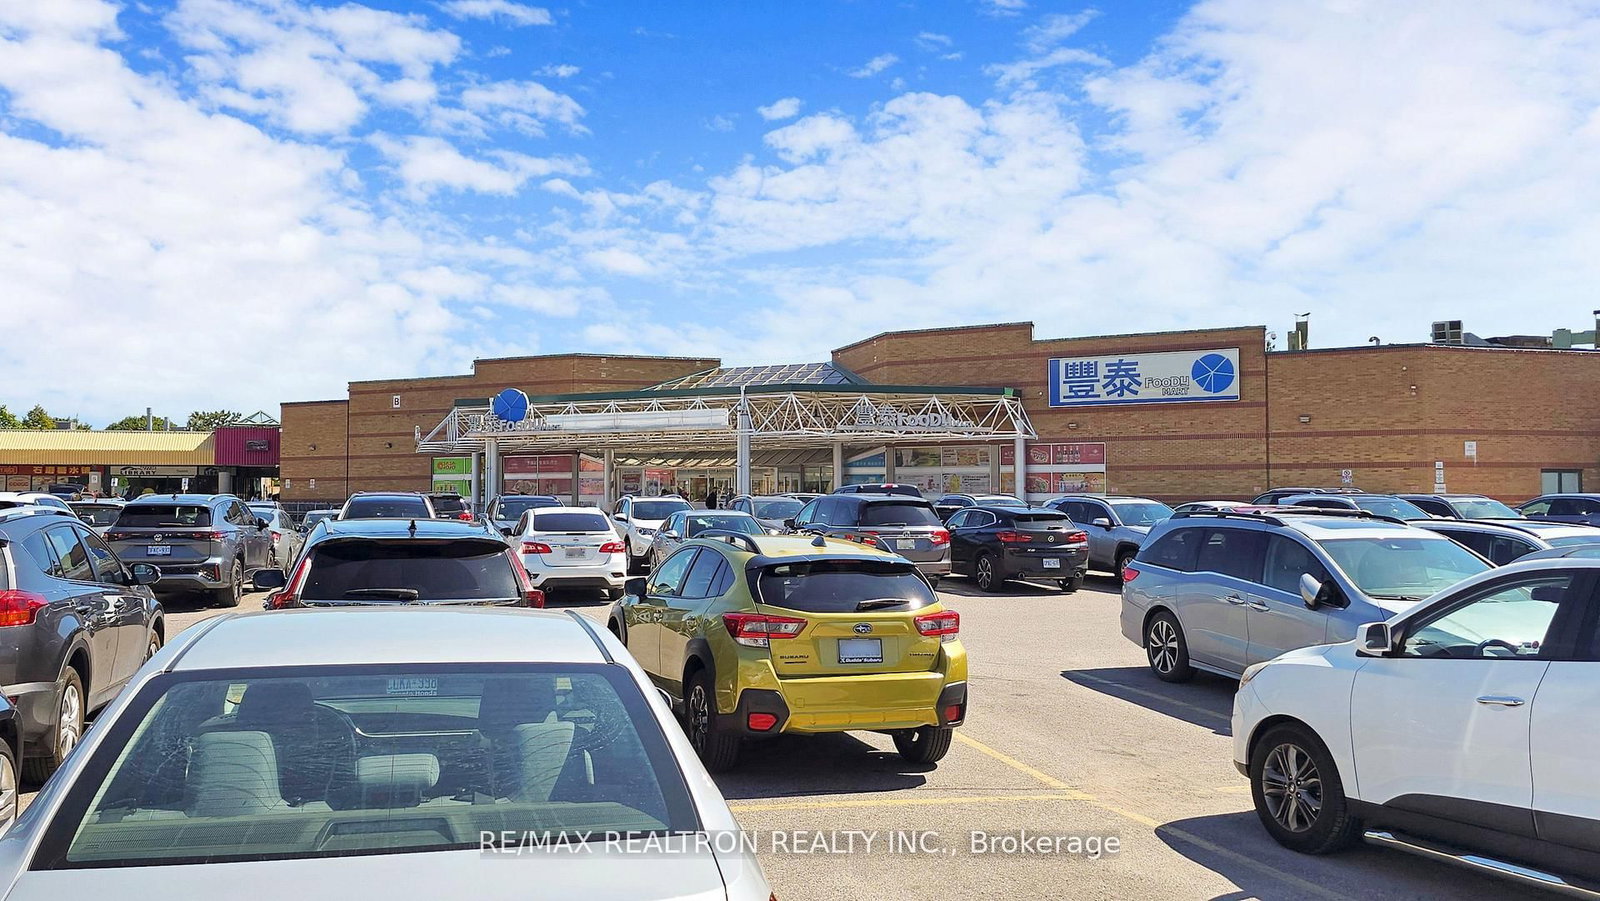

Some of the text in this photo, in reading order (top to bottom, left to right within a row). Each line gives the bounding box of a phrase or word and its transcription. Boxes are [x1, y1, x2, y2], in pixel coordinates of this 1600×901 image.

[1063, 359, 1143, 399] 豐泰
[1162, 387, 1189, 396] MART
[394, 398, 400, 406] B
